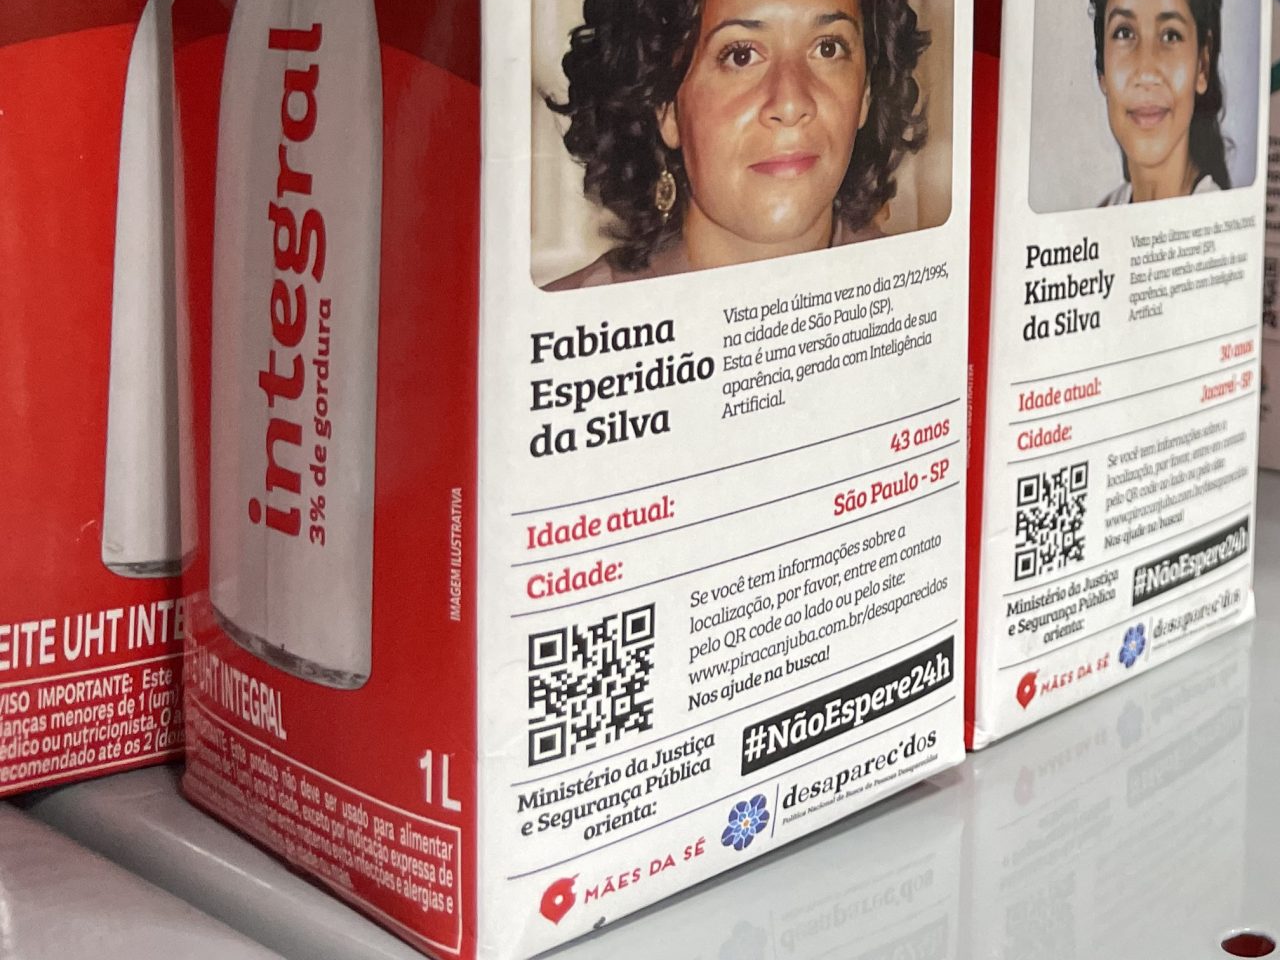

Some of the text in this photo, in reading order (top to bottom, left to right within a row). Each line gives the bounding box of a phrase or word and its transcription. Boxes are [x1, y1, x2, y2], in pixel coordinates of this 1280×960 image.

[248, 23, 323, 540] integral
[1025, 237, 1100, 270] Pamela
[723, 262, 949, 324] Vista pela última vez no dia 23/12/1995,
[1024, 269, 1115, 305] Kimberly
[530, 319, 675, 364] Fabiana
[723, 297, 893, 348] na cidade de São Paulo (SP).
[723, 310, 937, 371] Esta é uma versão atualizada de sua
[1023, 309, 1101, 342] da Silva
[530, 352, 715, 413] Esperidião
[722, 331, 932, 397] aparência, gerada com Inteligência
[309, 297, 332, 547] 3% de gordura
[722, 390, 786, 419] Artificial.
[1018, 377, 1102, 412] Idade atual:
[530, 409, 670, 458] da Silva
[890, 418, 950, 453] 43 anos
[1017, 425, 1073, 452] Cidade:
[833, 459, 950, 517] São Paulo SP
[526, 494, 676, 550] Idade atual:
[449, 487, 463, 623] IMAGEM ILUSTRATIVA
[526, 560, 624, 601] Cidade:
[690, 529, 895, 608] Se você tem informações sobre
[1134, 526, 1247, 597] #NãoEspere24h
[689, 533, 942, 634] localização, por favor, entre em contato
[1006, 569, 1119, 618] Ministério da Justiça
[1017, 587, 1116, 634] Segurança Pública
[0, 597, 186, 670] EITE UHT INTE
[688, 570, 906, 665] pelo QR code ao lado ou pelo site:
[688, 576, 948, 685] www.piracanjuba.com.br/desaparecidos
[1043, 618, 1085, 644] orienta:
[0, 667, 173, 714] VISO IMPORTANTE: Este
[221, 661, 287, 740] INTEGRAL
[688, 644, 831, 712] Nos ajude na busca!
[744, 650, 950, 762] #NãoEspere24h
[0, 713, 157, 758] édico ou nutricionista.
[51, 700, 113, 730] menores
[118, 698, 134, 717] de
[0, 731, 152, 781] ecomendado até os 2
[517, 732, 716, 814] Ministério da Justiça
[300, 775, 453, 859] deve ser usado para alimentar
[537, 756, 711, 837] Segurança Pública
[582, 800, 657, 842] orienta:
[391, 849, 436, 883] expressa
[439, 861, 453, 888] de
[403, 875, 444, 912] alergias
[583, 836, 706, 904] MÃES DA SÉ
